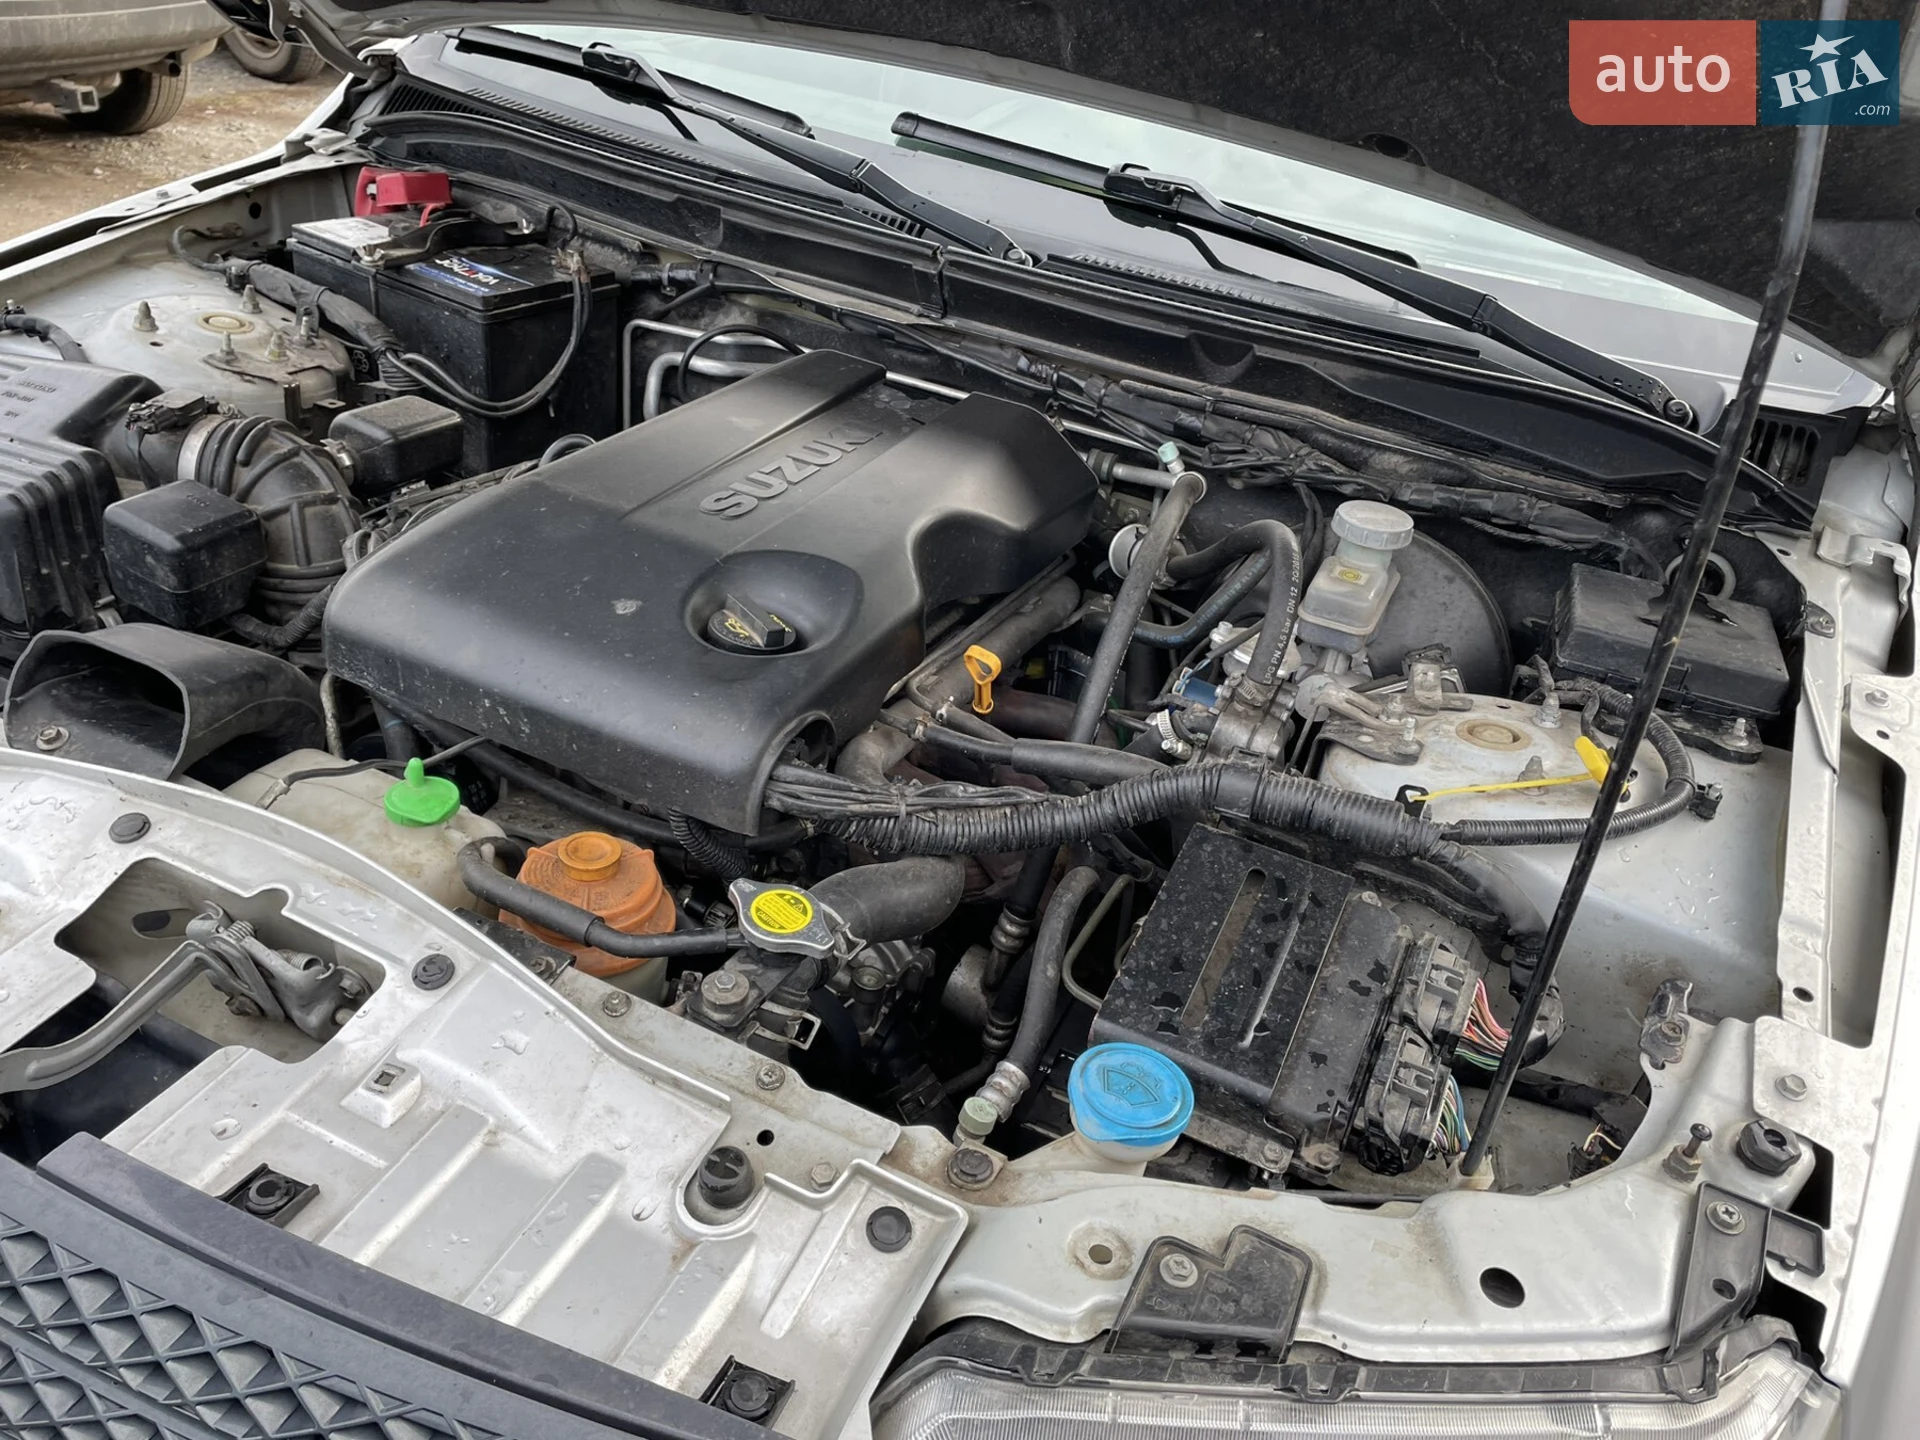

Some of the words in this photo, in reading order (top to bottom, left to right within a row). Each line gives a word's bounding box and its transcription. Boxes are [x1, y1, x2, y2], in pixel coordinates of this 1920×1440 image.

[1290, 586, 1299, 597] 12
[1286, 598, 1296, 614] DN
[1281, 617, 1292, 634] bar
[1271, 650, 1282, 664] PN
[1263, 665, 1276, 684] LPG
[757, 910, 781, 929] CAUTION
